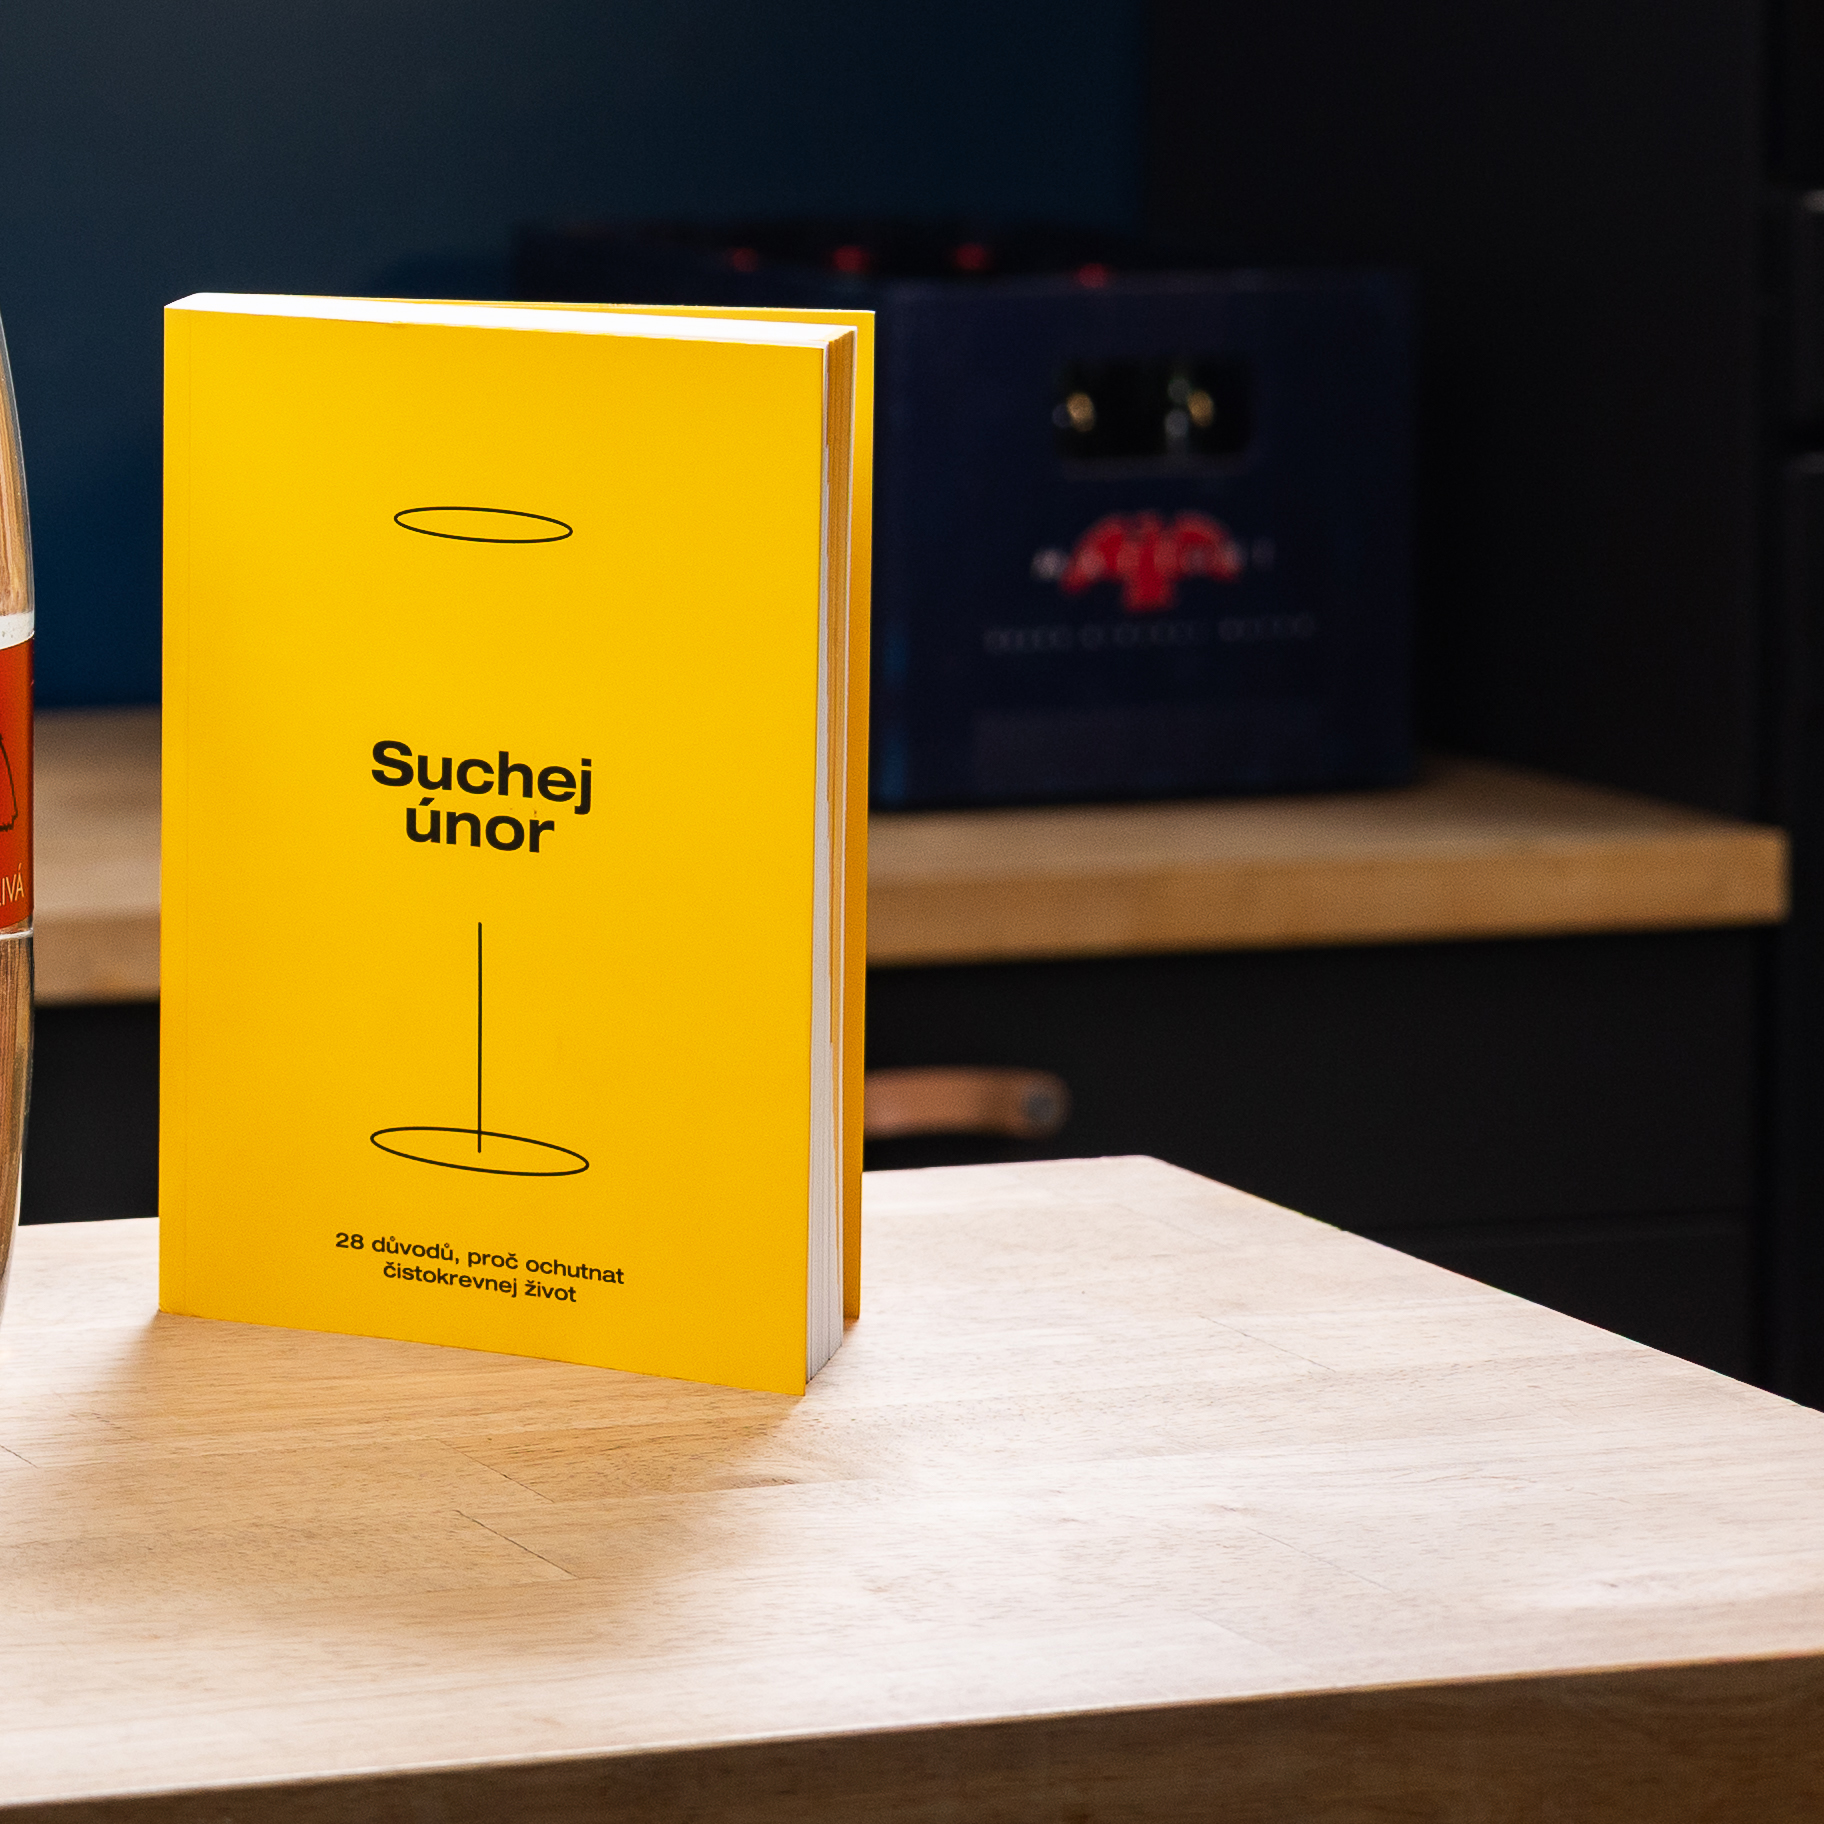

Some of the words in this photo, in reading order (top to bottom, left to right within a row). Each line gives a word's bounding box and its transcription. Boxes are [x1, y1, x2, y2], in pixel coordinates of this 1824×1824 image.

[371, 740, 592, 815] Suchej
[406, 796, 555, 853] únor
[335, 1232, 365, 1250] 28
[371, 1235, 460, 1265] důvodů,
[467, 1252, 519, 1270] proč
[525, 1259, 625, 1285] ochutnat
[383, 1261, 518, 1299] čistokrevnej
[524, 1280, 578, 1303] život
